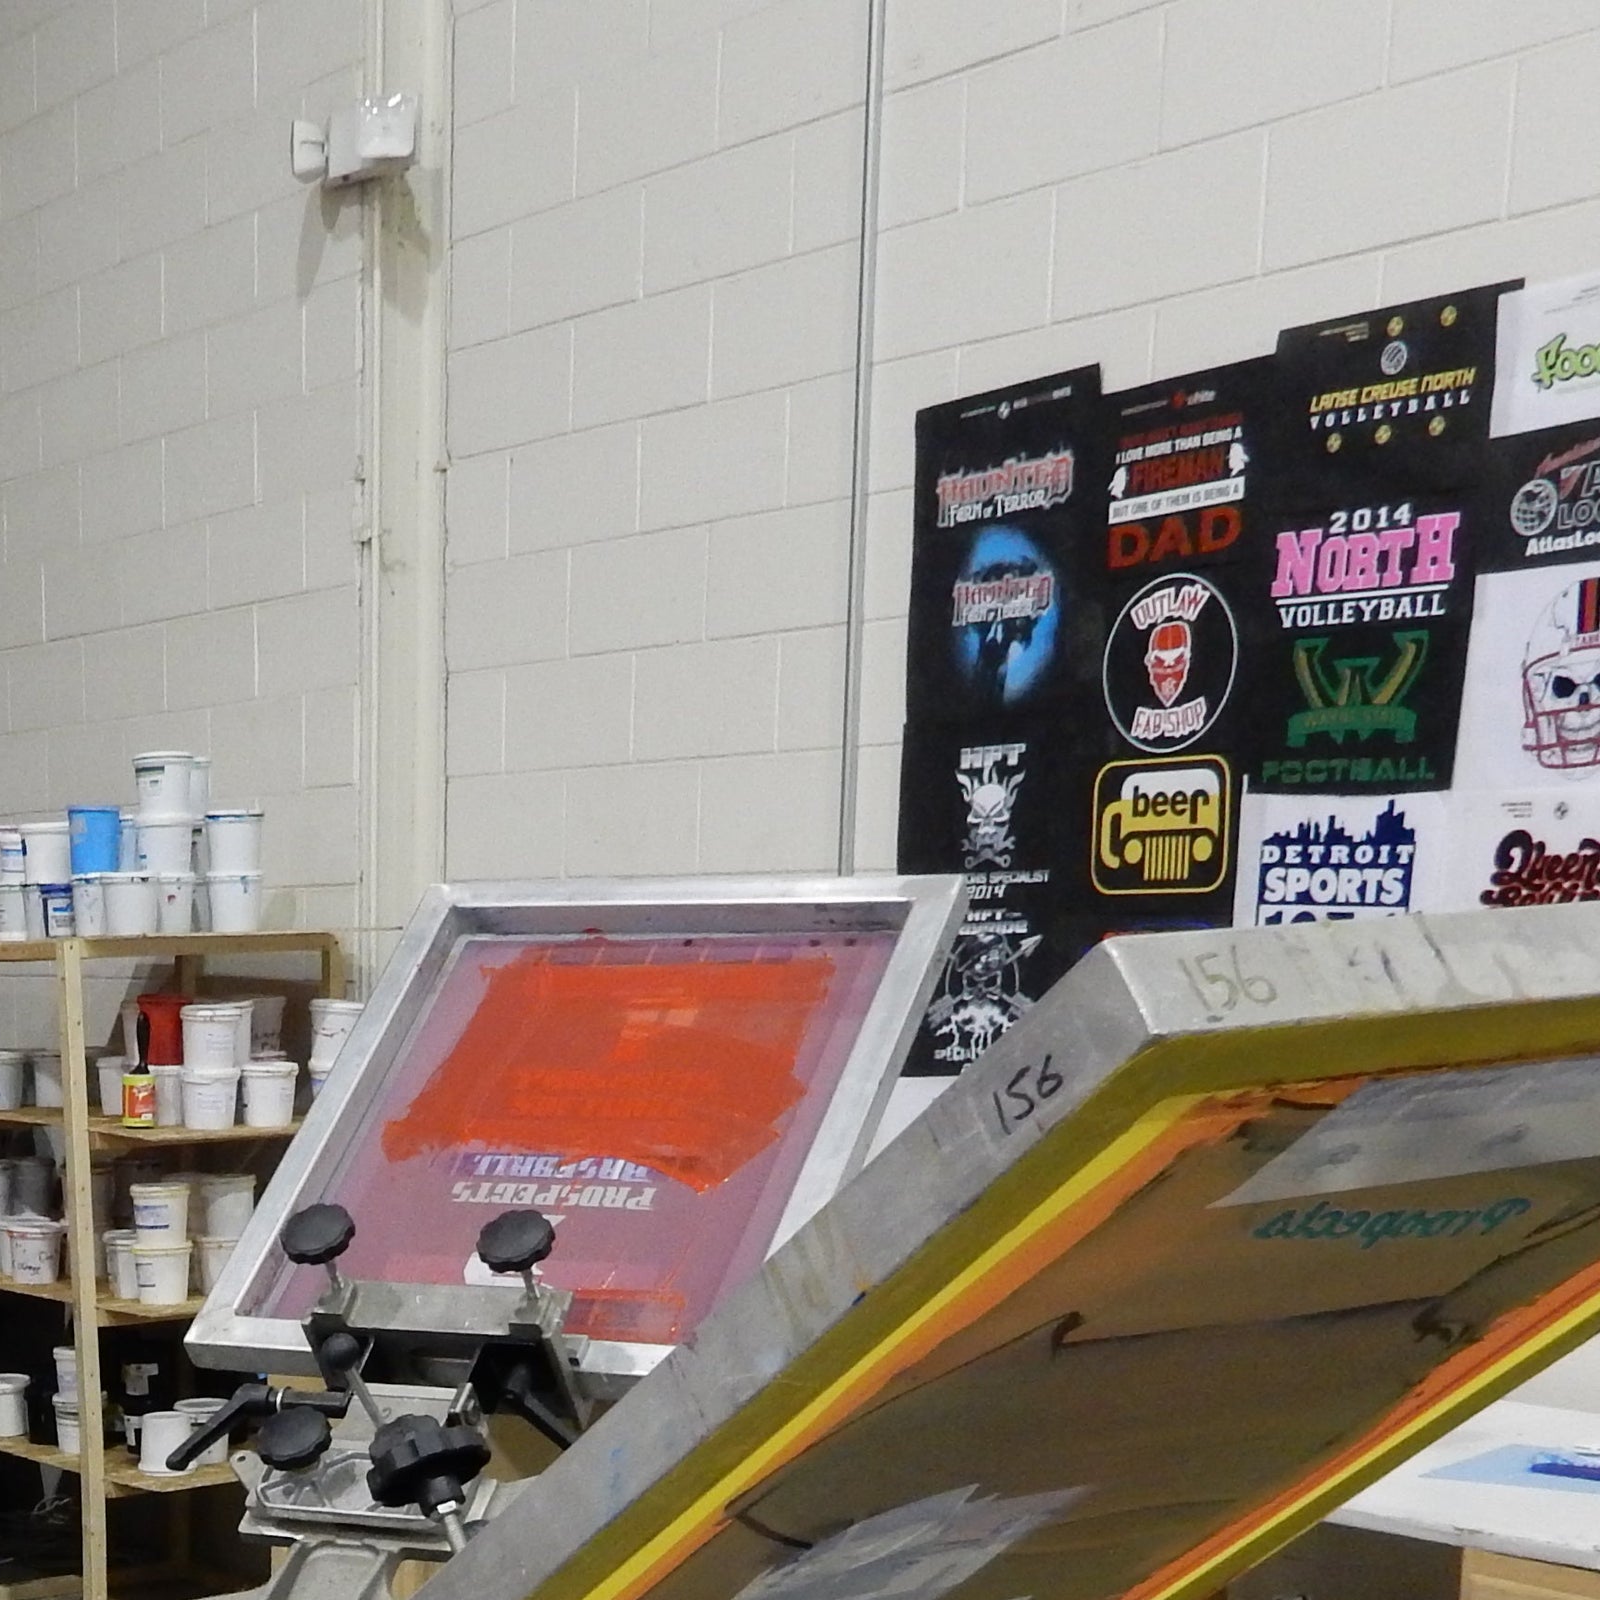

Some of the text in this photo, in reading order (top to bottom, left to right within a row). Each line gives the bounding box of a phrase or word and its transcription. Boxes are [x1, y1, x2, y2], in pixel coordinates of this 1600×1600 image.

[1360, 377, 1419, 404] CREUSE
[1421, 366, 1477, 393] NORTH
[1310, 389, 1470, 430] VOLLEYBALL
[1175, 435, 1202, 452] THAN
[1233, 425, 1243, 439] A
[994, 488, 1046, 517] TERROR
[1151, 498, 1163, 511] OF
[1329, 503, 1411, 534] 2014
[1107, 505, 1242, 570] DAD
[1271, 511, 1460, 597] NORTH
[1131, 584, 1210, 630] OUTLAW
[1279, 594, 1445, 629] VOLLEYBALL
[1131, 696, 1208, 740] FAB SHOP
[960, 743, 1027, 770] HPT
[1261, 757, 1436, 784] FOOTBALL
[1132, 785, 1211, 824] beer
[1261, 844, 1417, 865] DETROIT
[988, 869, 1050, 884] SPECIALIST
[1263, 867, 1405, 904] SPORTS
[1177, 944, 1279, 1012] 156
[993, 1053, 1064, 1136] 156
[452, 1181, 657, 1211] PROSPECTS
